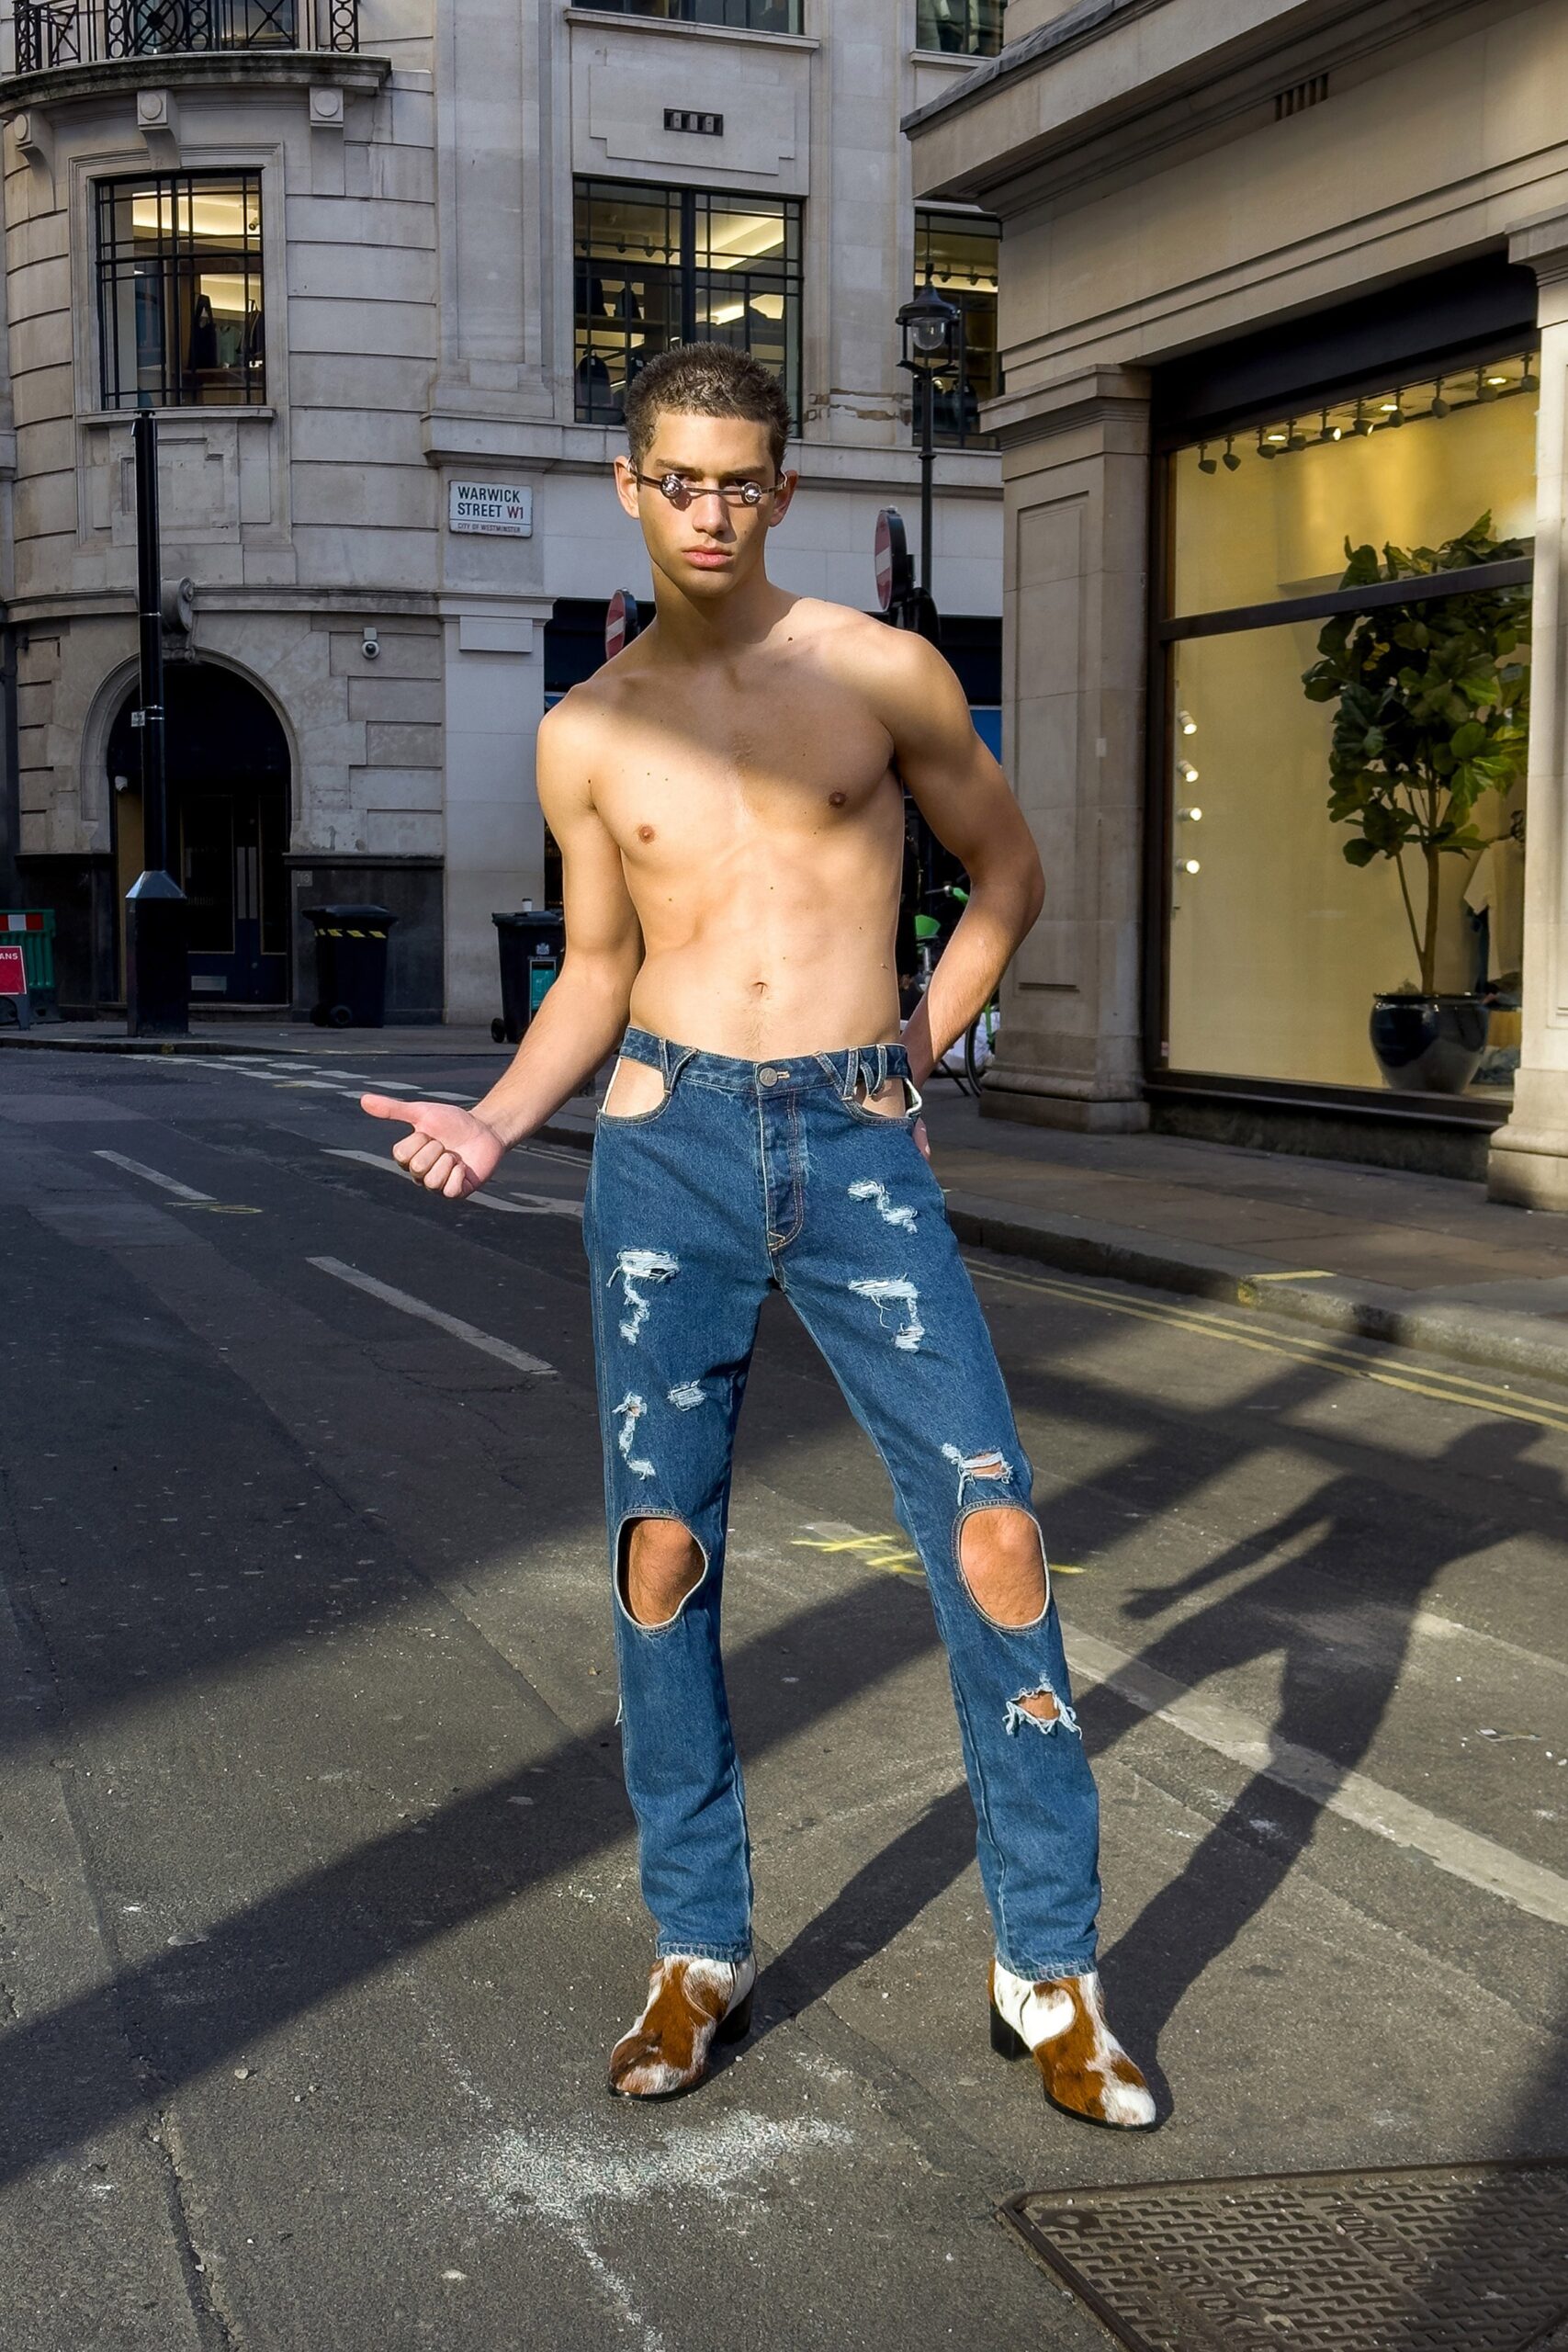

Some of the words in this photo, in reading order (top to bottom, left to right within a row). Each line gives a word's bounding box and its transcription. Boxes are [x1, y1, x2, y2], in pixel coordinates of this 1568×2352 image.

[457, 486, 521, 503] WARWICK
[457, 503, 502, 517] STREET
[507, 505, 524, 519] W1
[480, 524, 521, 532] WESTMINSTER
[0, 952, 18, 960] ANS
